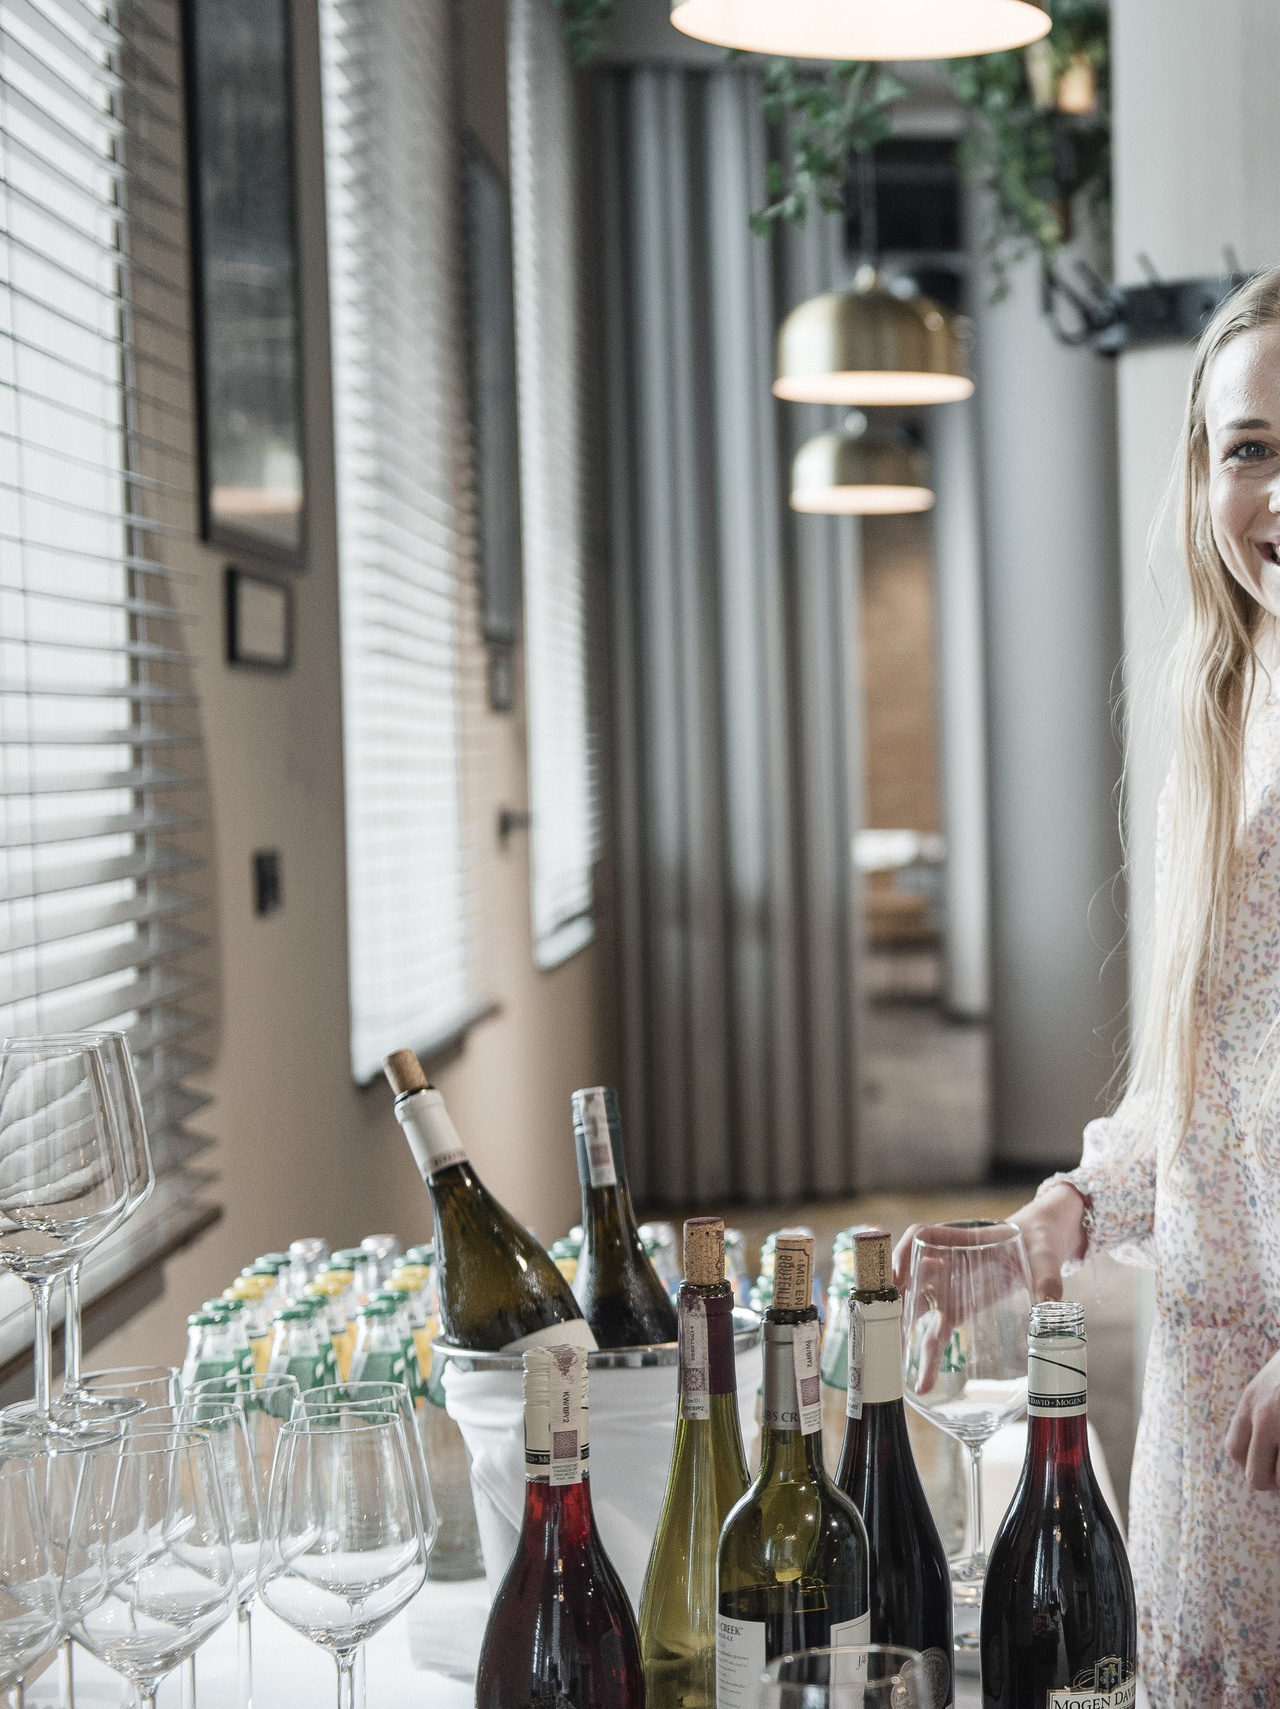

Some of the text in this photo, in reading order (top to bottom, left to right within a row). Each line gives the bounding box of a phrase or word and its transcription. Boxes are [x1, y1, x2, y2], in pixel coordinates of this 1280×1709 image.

[794, 1290, 804, 1306] EN
[1030, 1397, 1050, 1406] DAVID
[1055, 1397, 1082, 1407] MOGEN
[1053, 1696, 1111, 1709] MOGEN
